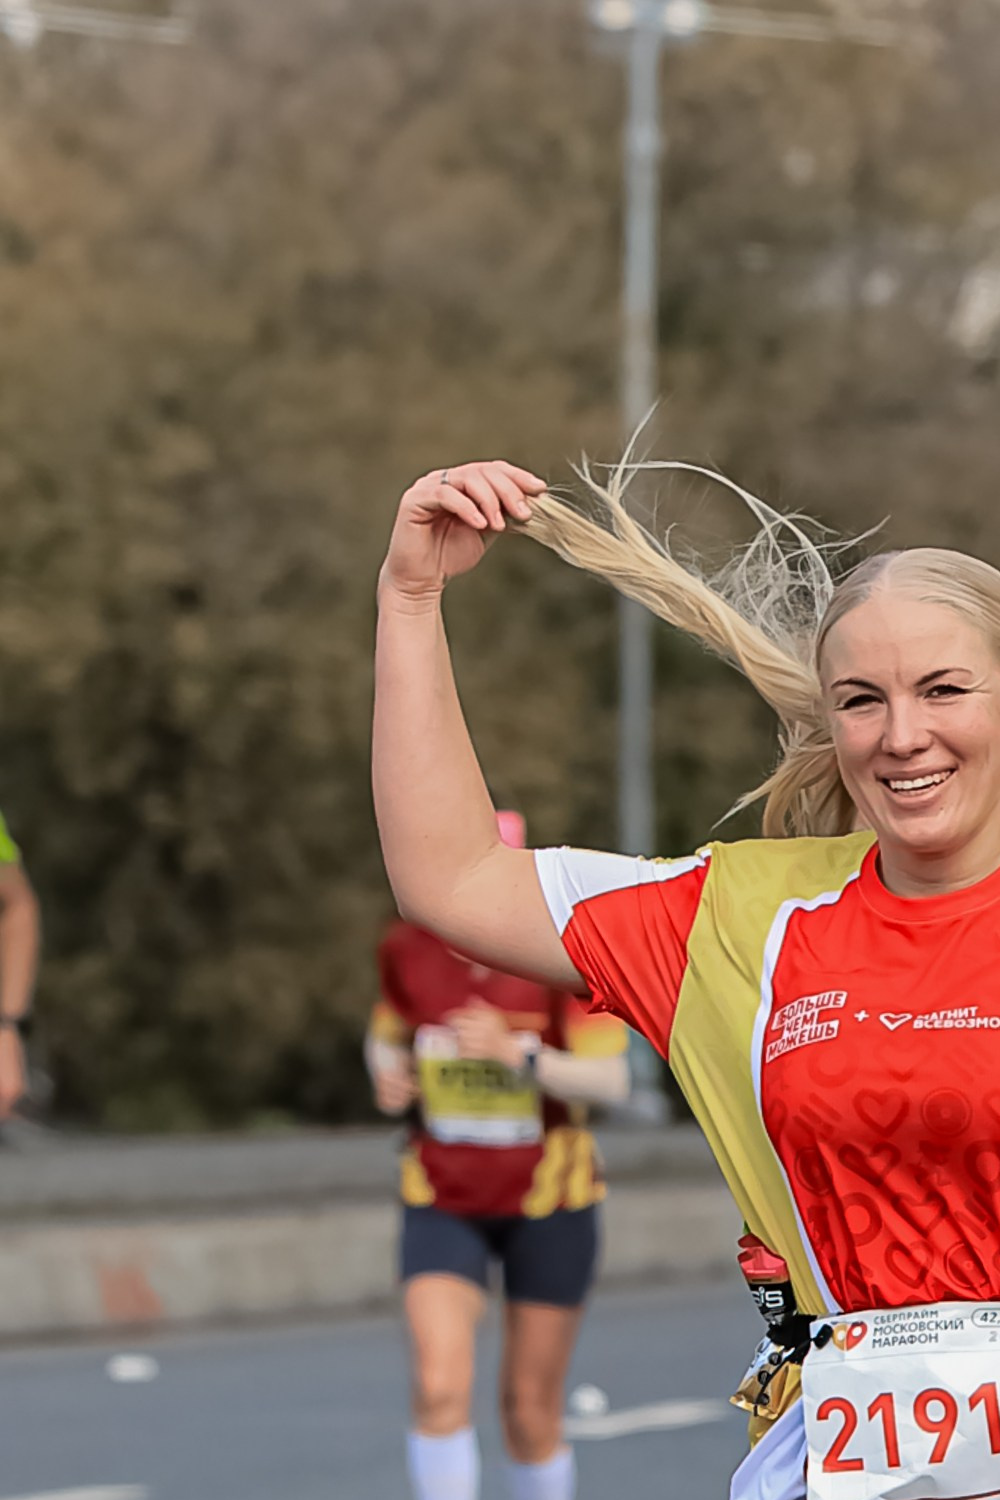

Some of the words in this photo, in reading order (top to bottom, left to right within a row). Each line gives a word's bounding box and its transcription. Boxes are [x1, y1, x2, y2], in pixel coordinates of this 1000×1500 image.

[775, 992, 844, 1027] БОЛЬШЕ
[785, 1011, 816, 1034] ЧЕМ
[767, 1023, 836, 1060] МОЖЕШЬ
[872, 1317, 965, 1336] МОСКОВСКИЙ
[873, 1309, 939, 1325] СБЕРПРАЙМ
[871, 1333, 939, 1349] МАРАФОН
